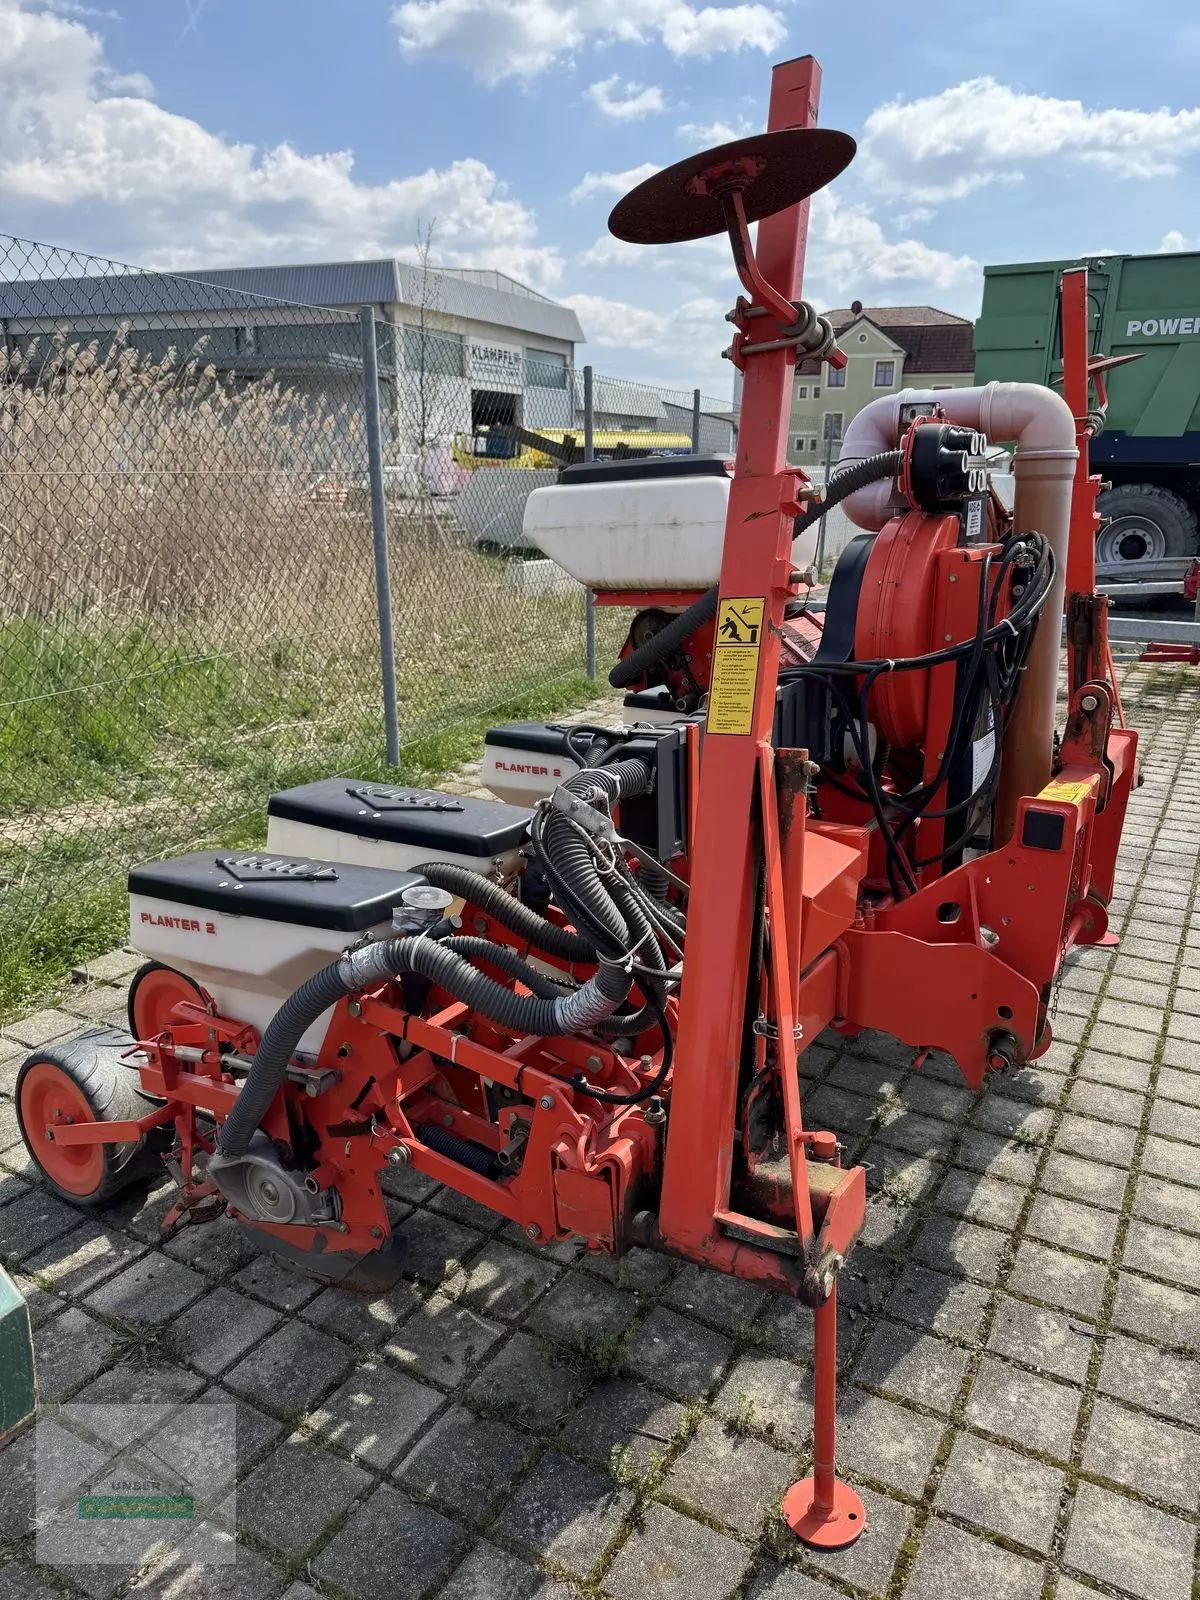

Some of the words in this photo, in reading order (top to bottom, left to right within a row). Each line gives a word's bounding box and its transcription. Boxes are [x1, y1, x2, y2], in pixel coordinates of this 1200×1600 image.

[495, 761, 548, 776] PLANTER
[553, 768, 561, 777] 2
[140, 912, 200, 932] PLANTER
[205, 922, 216, 934] 2
